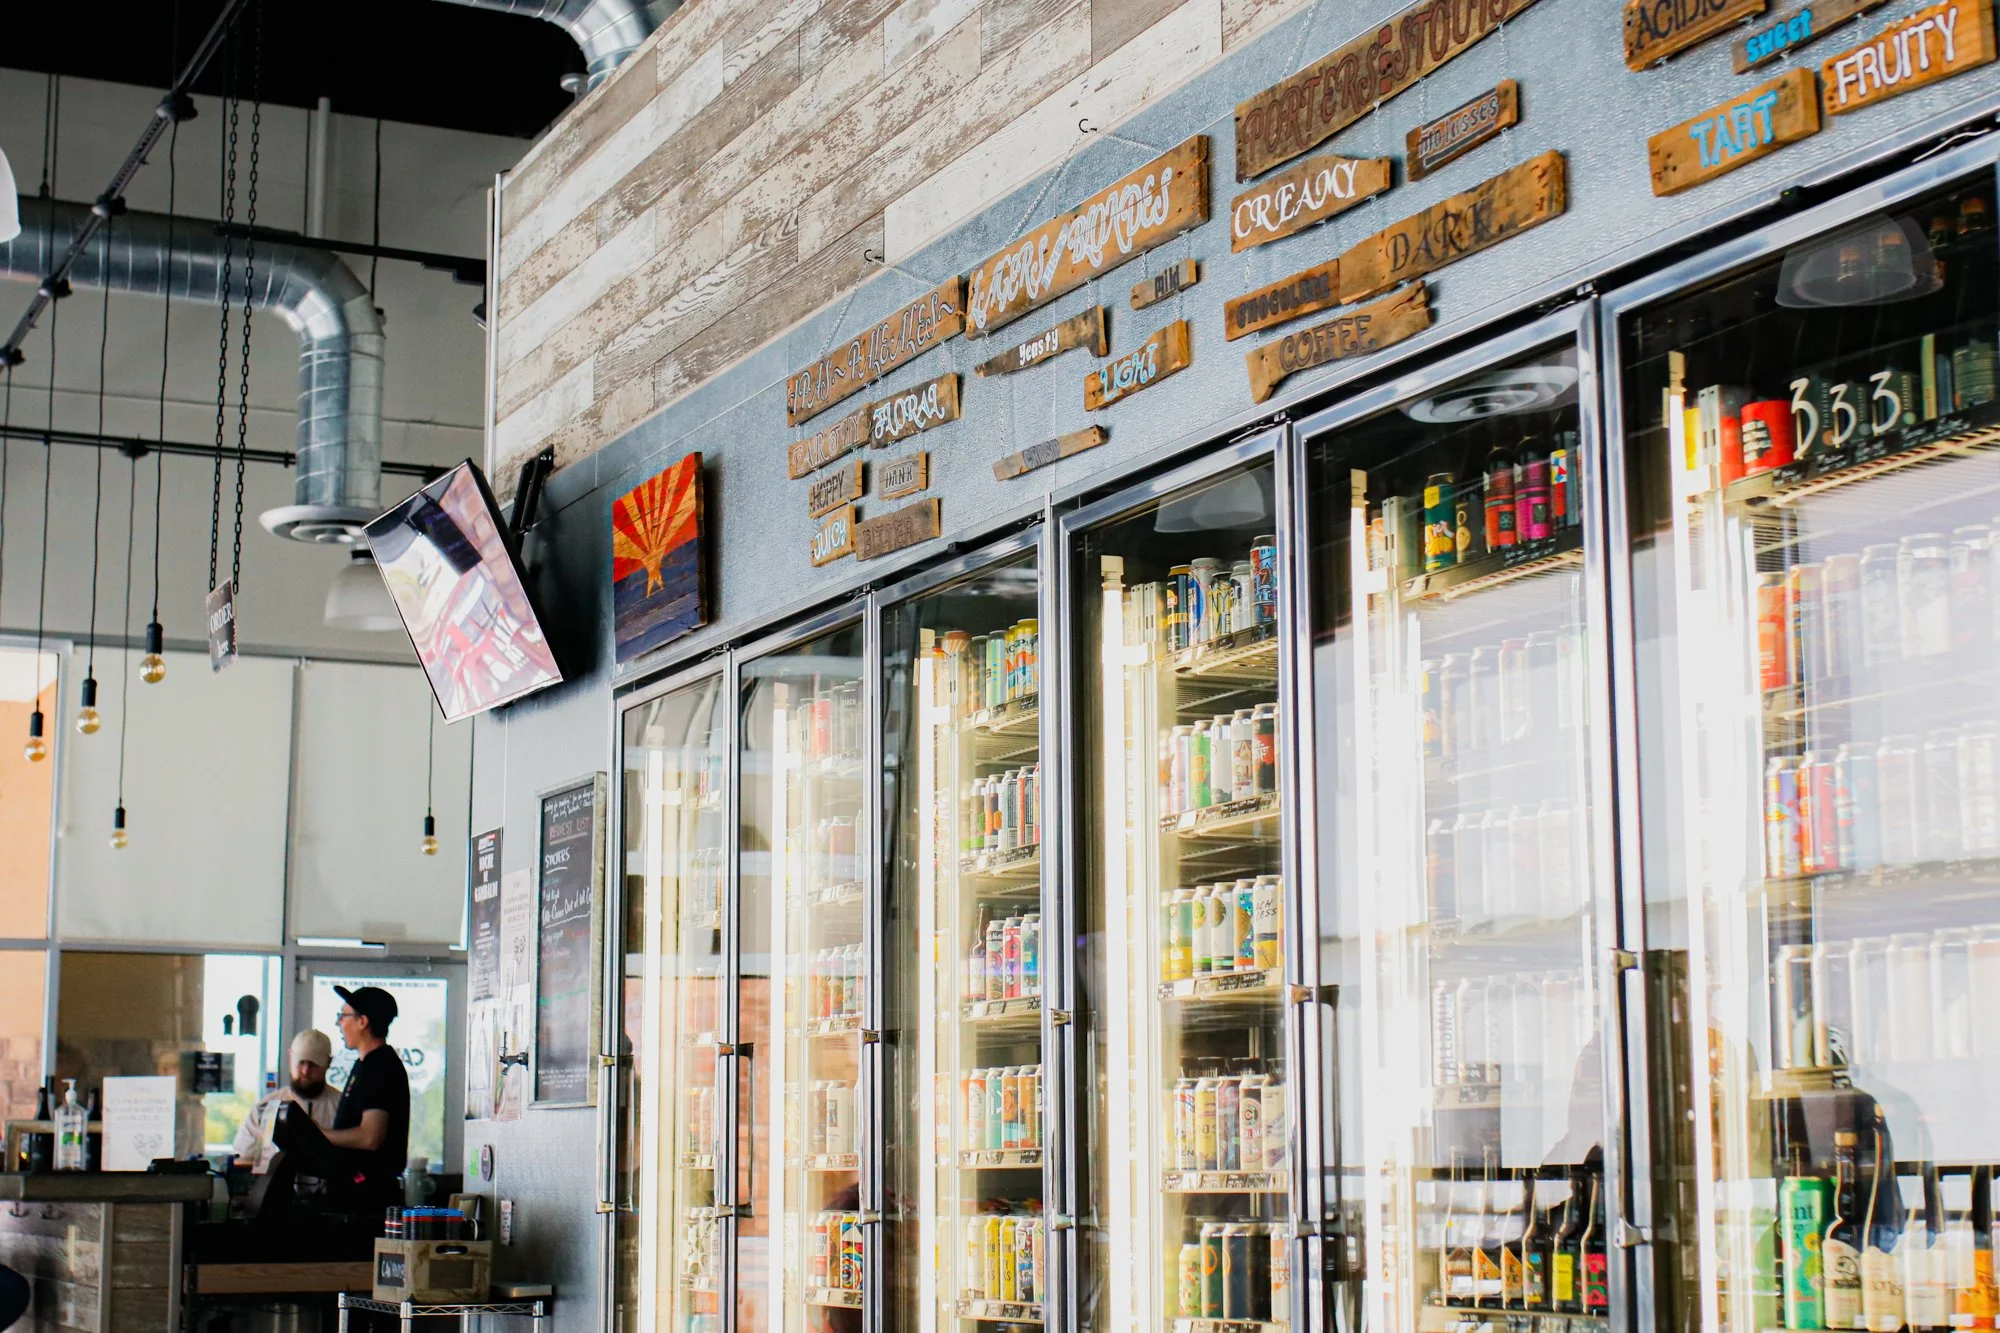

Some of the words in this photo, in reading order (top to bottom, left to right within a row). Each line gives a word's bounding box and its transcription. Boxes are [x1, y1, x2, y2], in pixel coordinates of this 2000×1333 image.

[1834, 7, 1958, 105] FRUITY
[1688, 90, 1778, 168] TART
[1234, 160, 1359, 239] CREAMY
[1386, 198, 1496, 273] DARK
[1100, 343, 1158, 401] LIGHT
[1278, 314, 1376, 373] COFFEE
[873, 384, 946, 440] FLORAL
[812, 470, 845, 511] HOPPY
[885, 465, 913, 489] DANK
[814, 517, 846, 561] JUICY
[210, 602, 233, 634] ORDER
